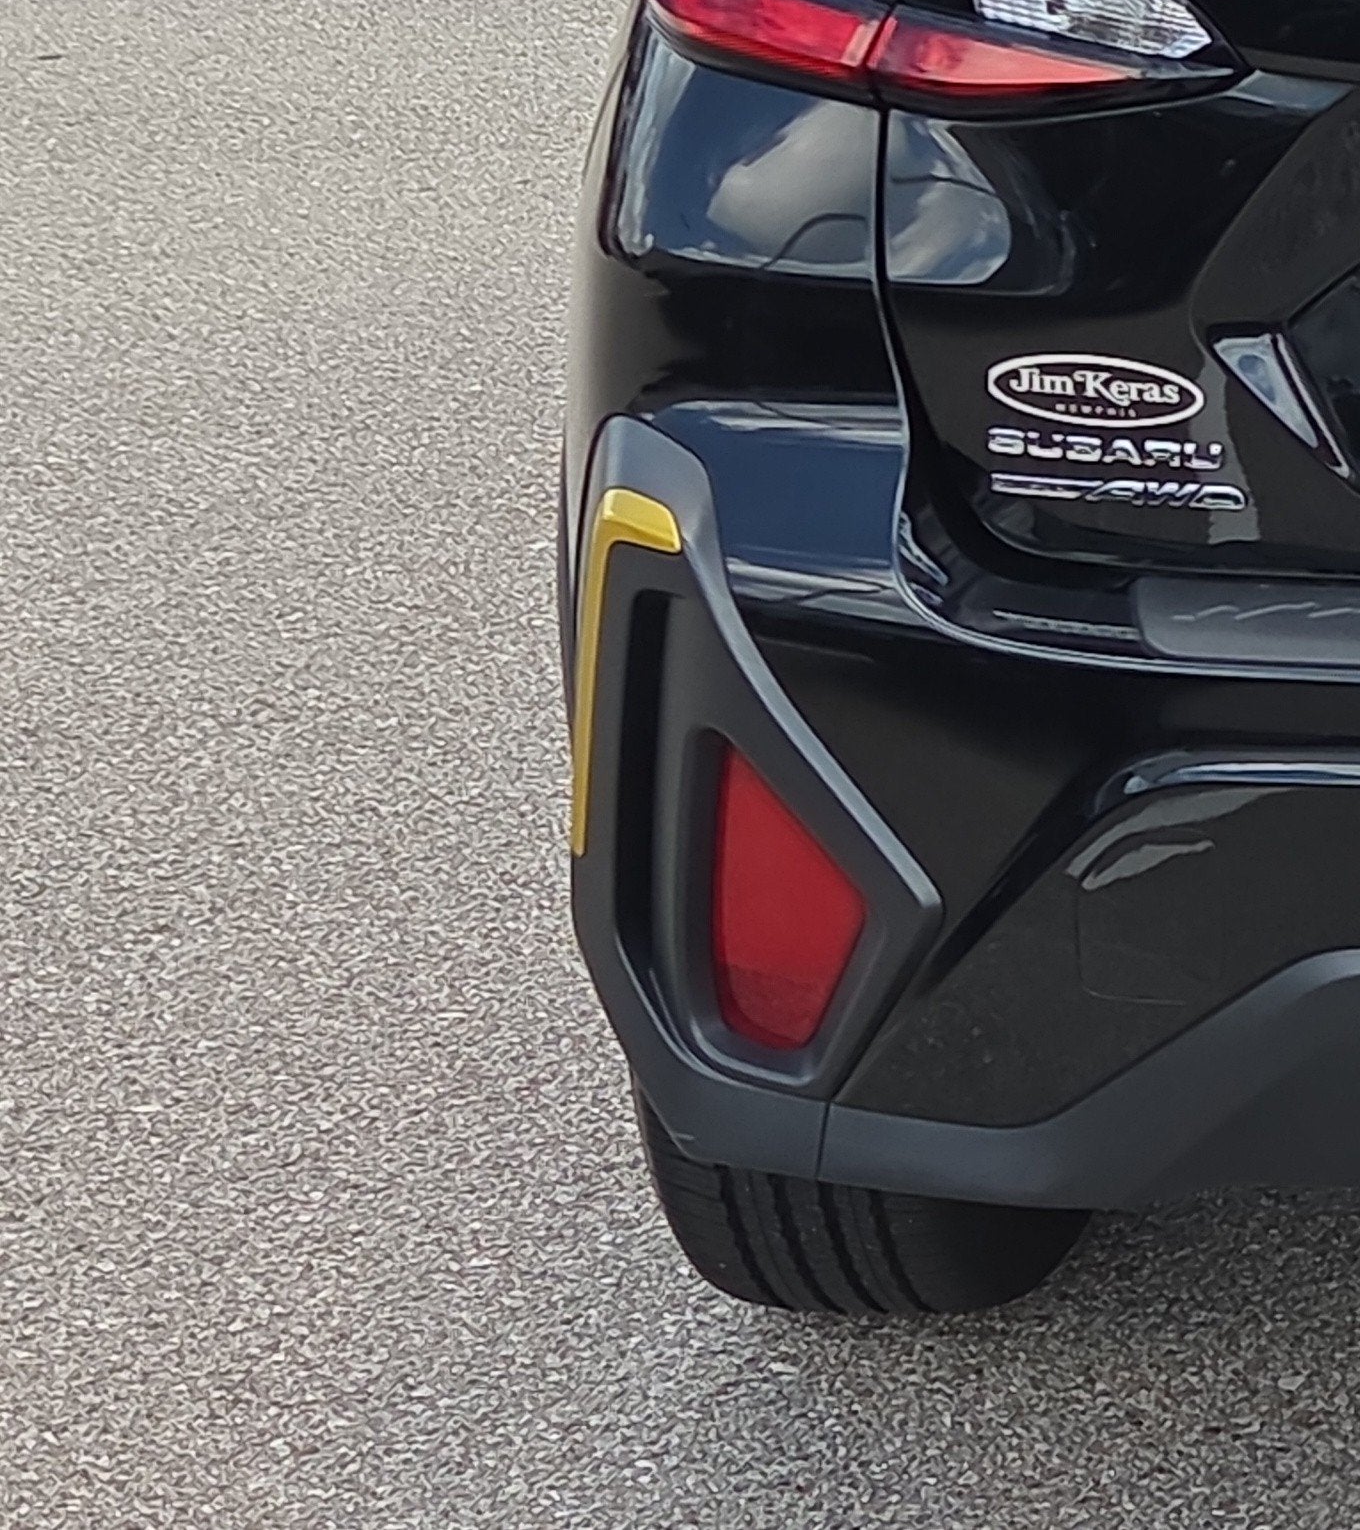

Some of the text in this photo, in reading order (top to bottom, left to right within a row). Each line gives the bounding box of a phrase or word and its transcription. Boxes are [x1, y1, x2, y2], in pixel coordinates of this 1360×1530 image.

[1008, 367, 1180, 407] Jim Keras
[987, 428, 1223, 469] SUBARU
[1084, 478, 1246, 510] AWD
